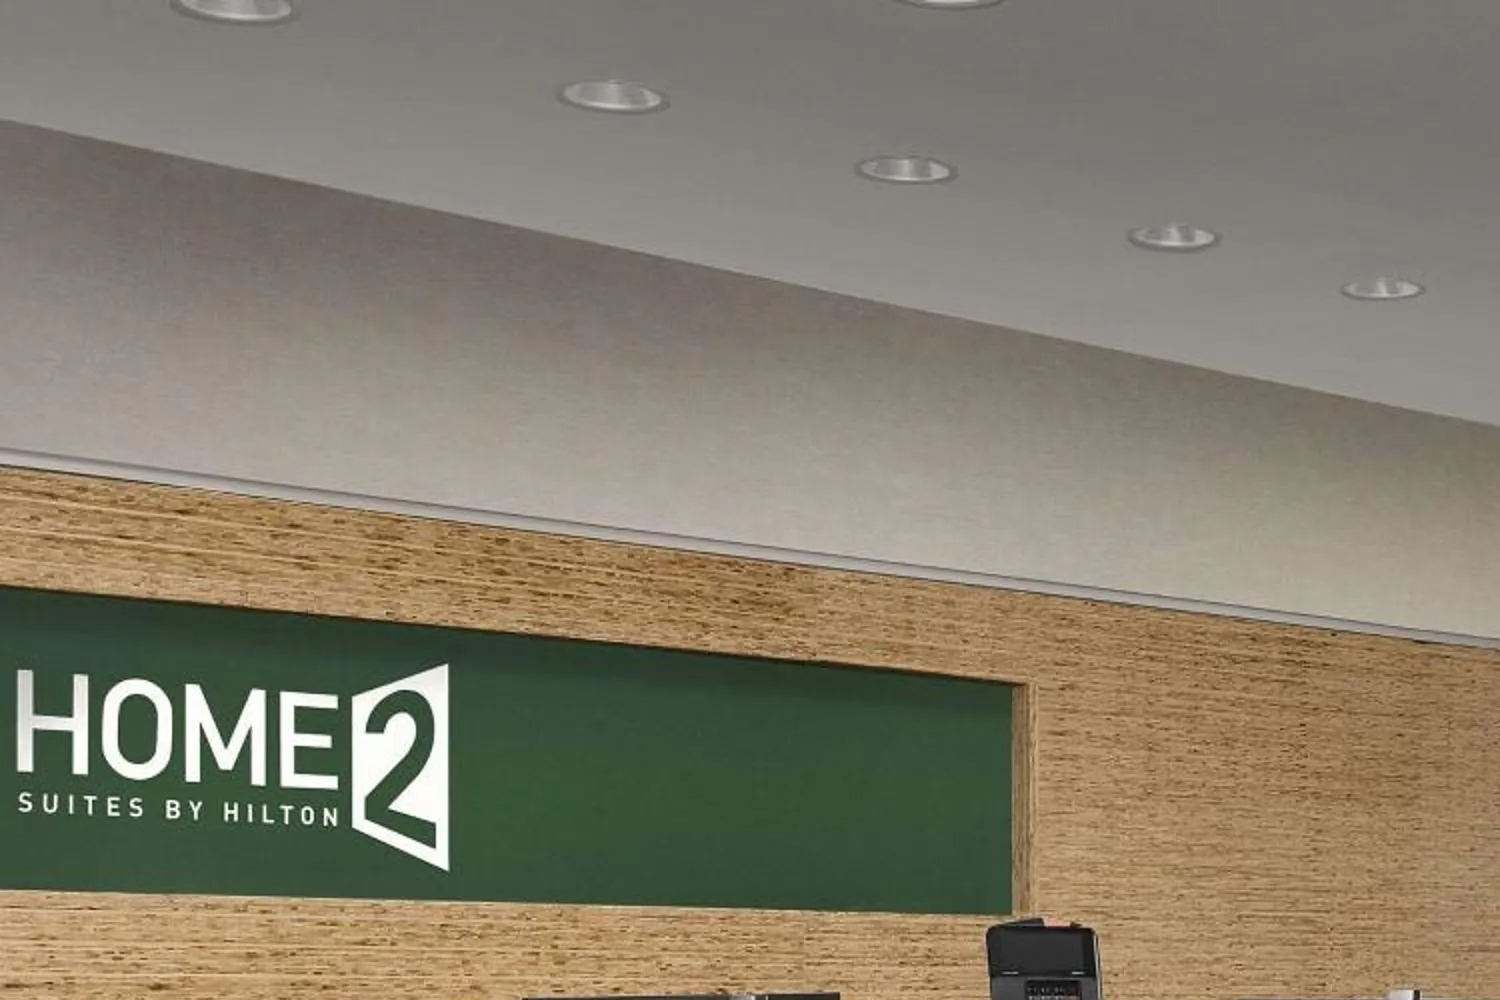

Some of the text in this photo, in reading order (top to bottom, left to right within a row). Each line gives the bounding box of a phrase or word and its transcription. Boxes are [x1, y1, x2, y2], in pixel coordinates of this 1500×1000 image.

[17, 791, 338, 827] SUITES BY HILTON
